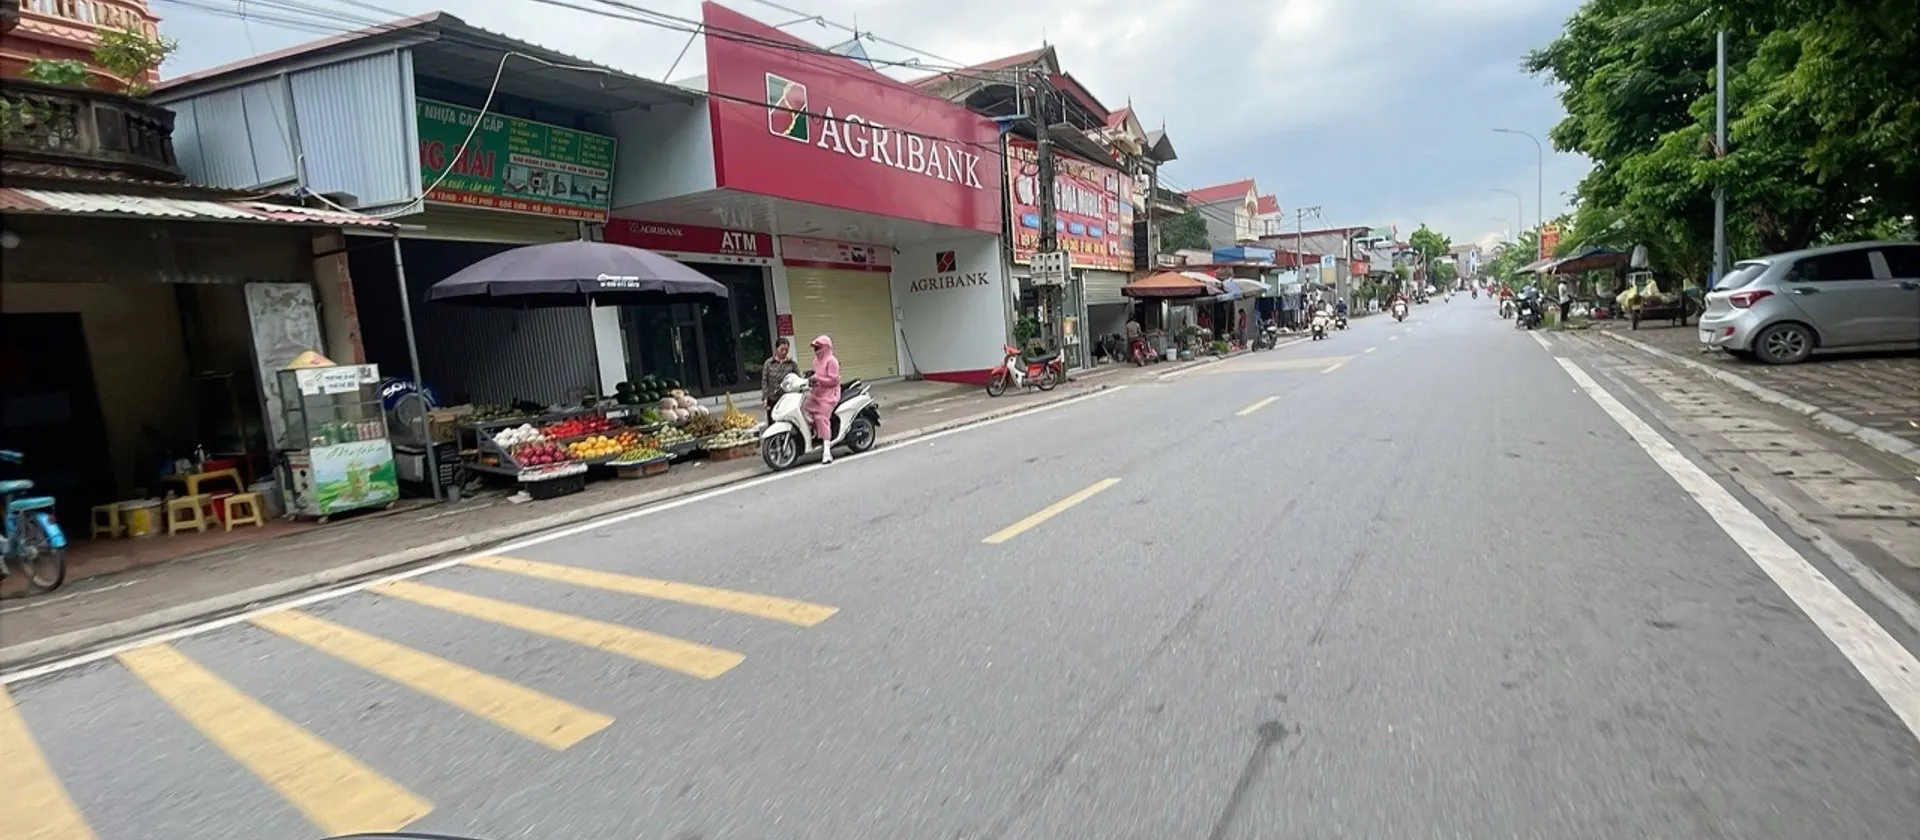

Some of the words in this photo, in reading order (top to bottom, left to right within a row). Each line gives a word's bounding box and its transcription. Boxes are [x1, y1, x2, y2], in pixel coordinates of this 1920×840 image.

[817, 106, 984, 190] AGRIBANK
[640, 224, 683, 237] AGRIBANK
[721, 231, 758, 251] ATM
[910, 272, 990, 292] AGRIBANK
